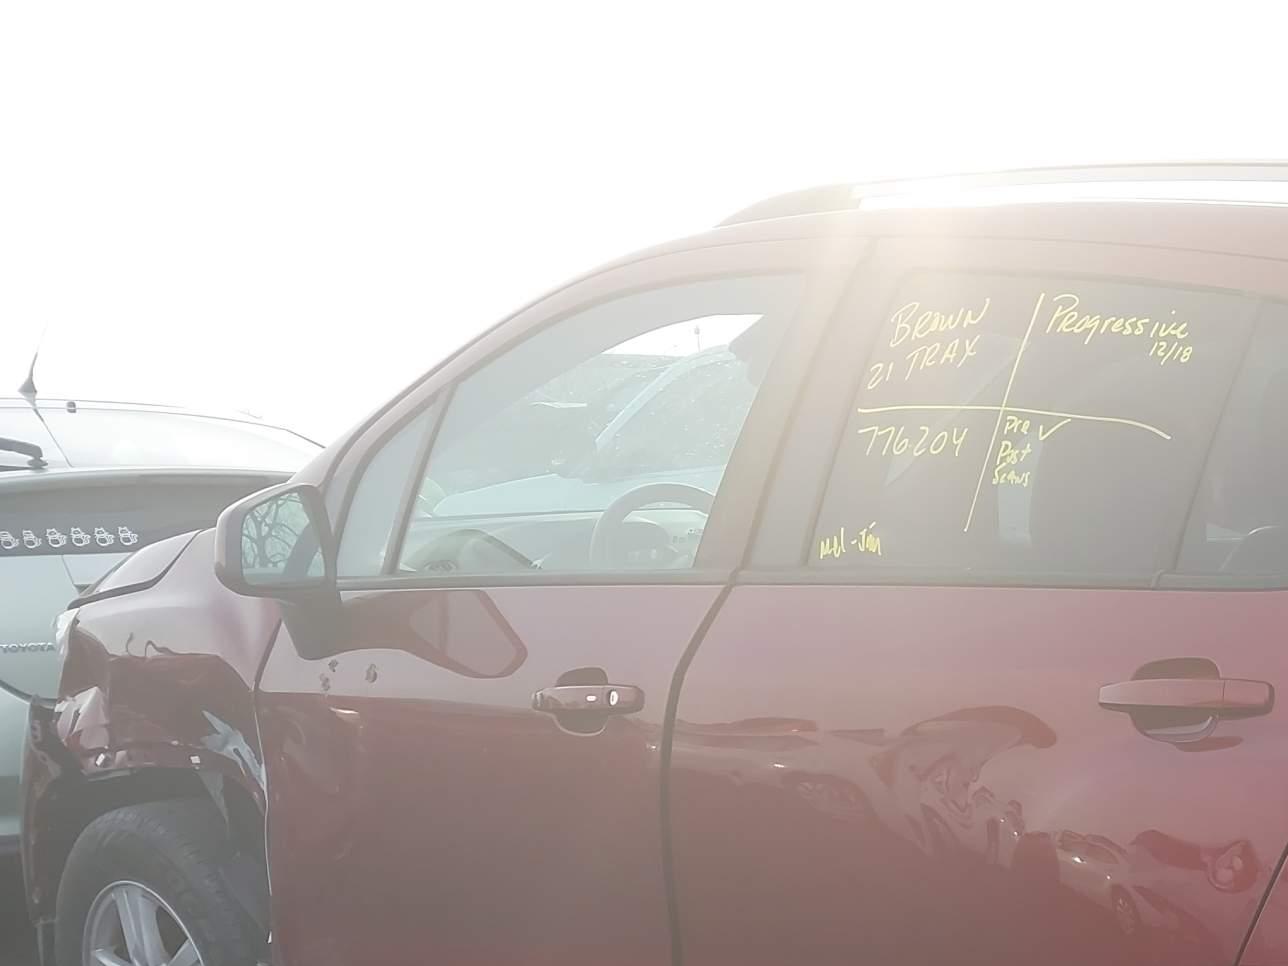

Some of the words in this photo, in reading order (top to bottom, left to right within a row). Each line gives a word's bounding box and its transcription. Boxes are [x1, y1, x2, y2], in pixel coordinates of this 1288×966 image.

[867, 362, 894, 390] 21
[904, 334, 981, 381] TRAX
[1149, 341, 1193, 366] 12/18
[0, 641, 56, 654] TOYOTA
